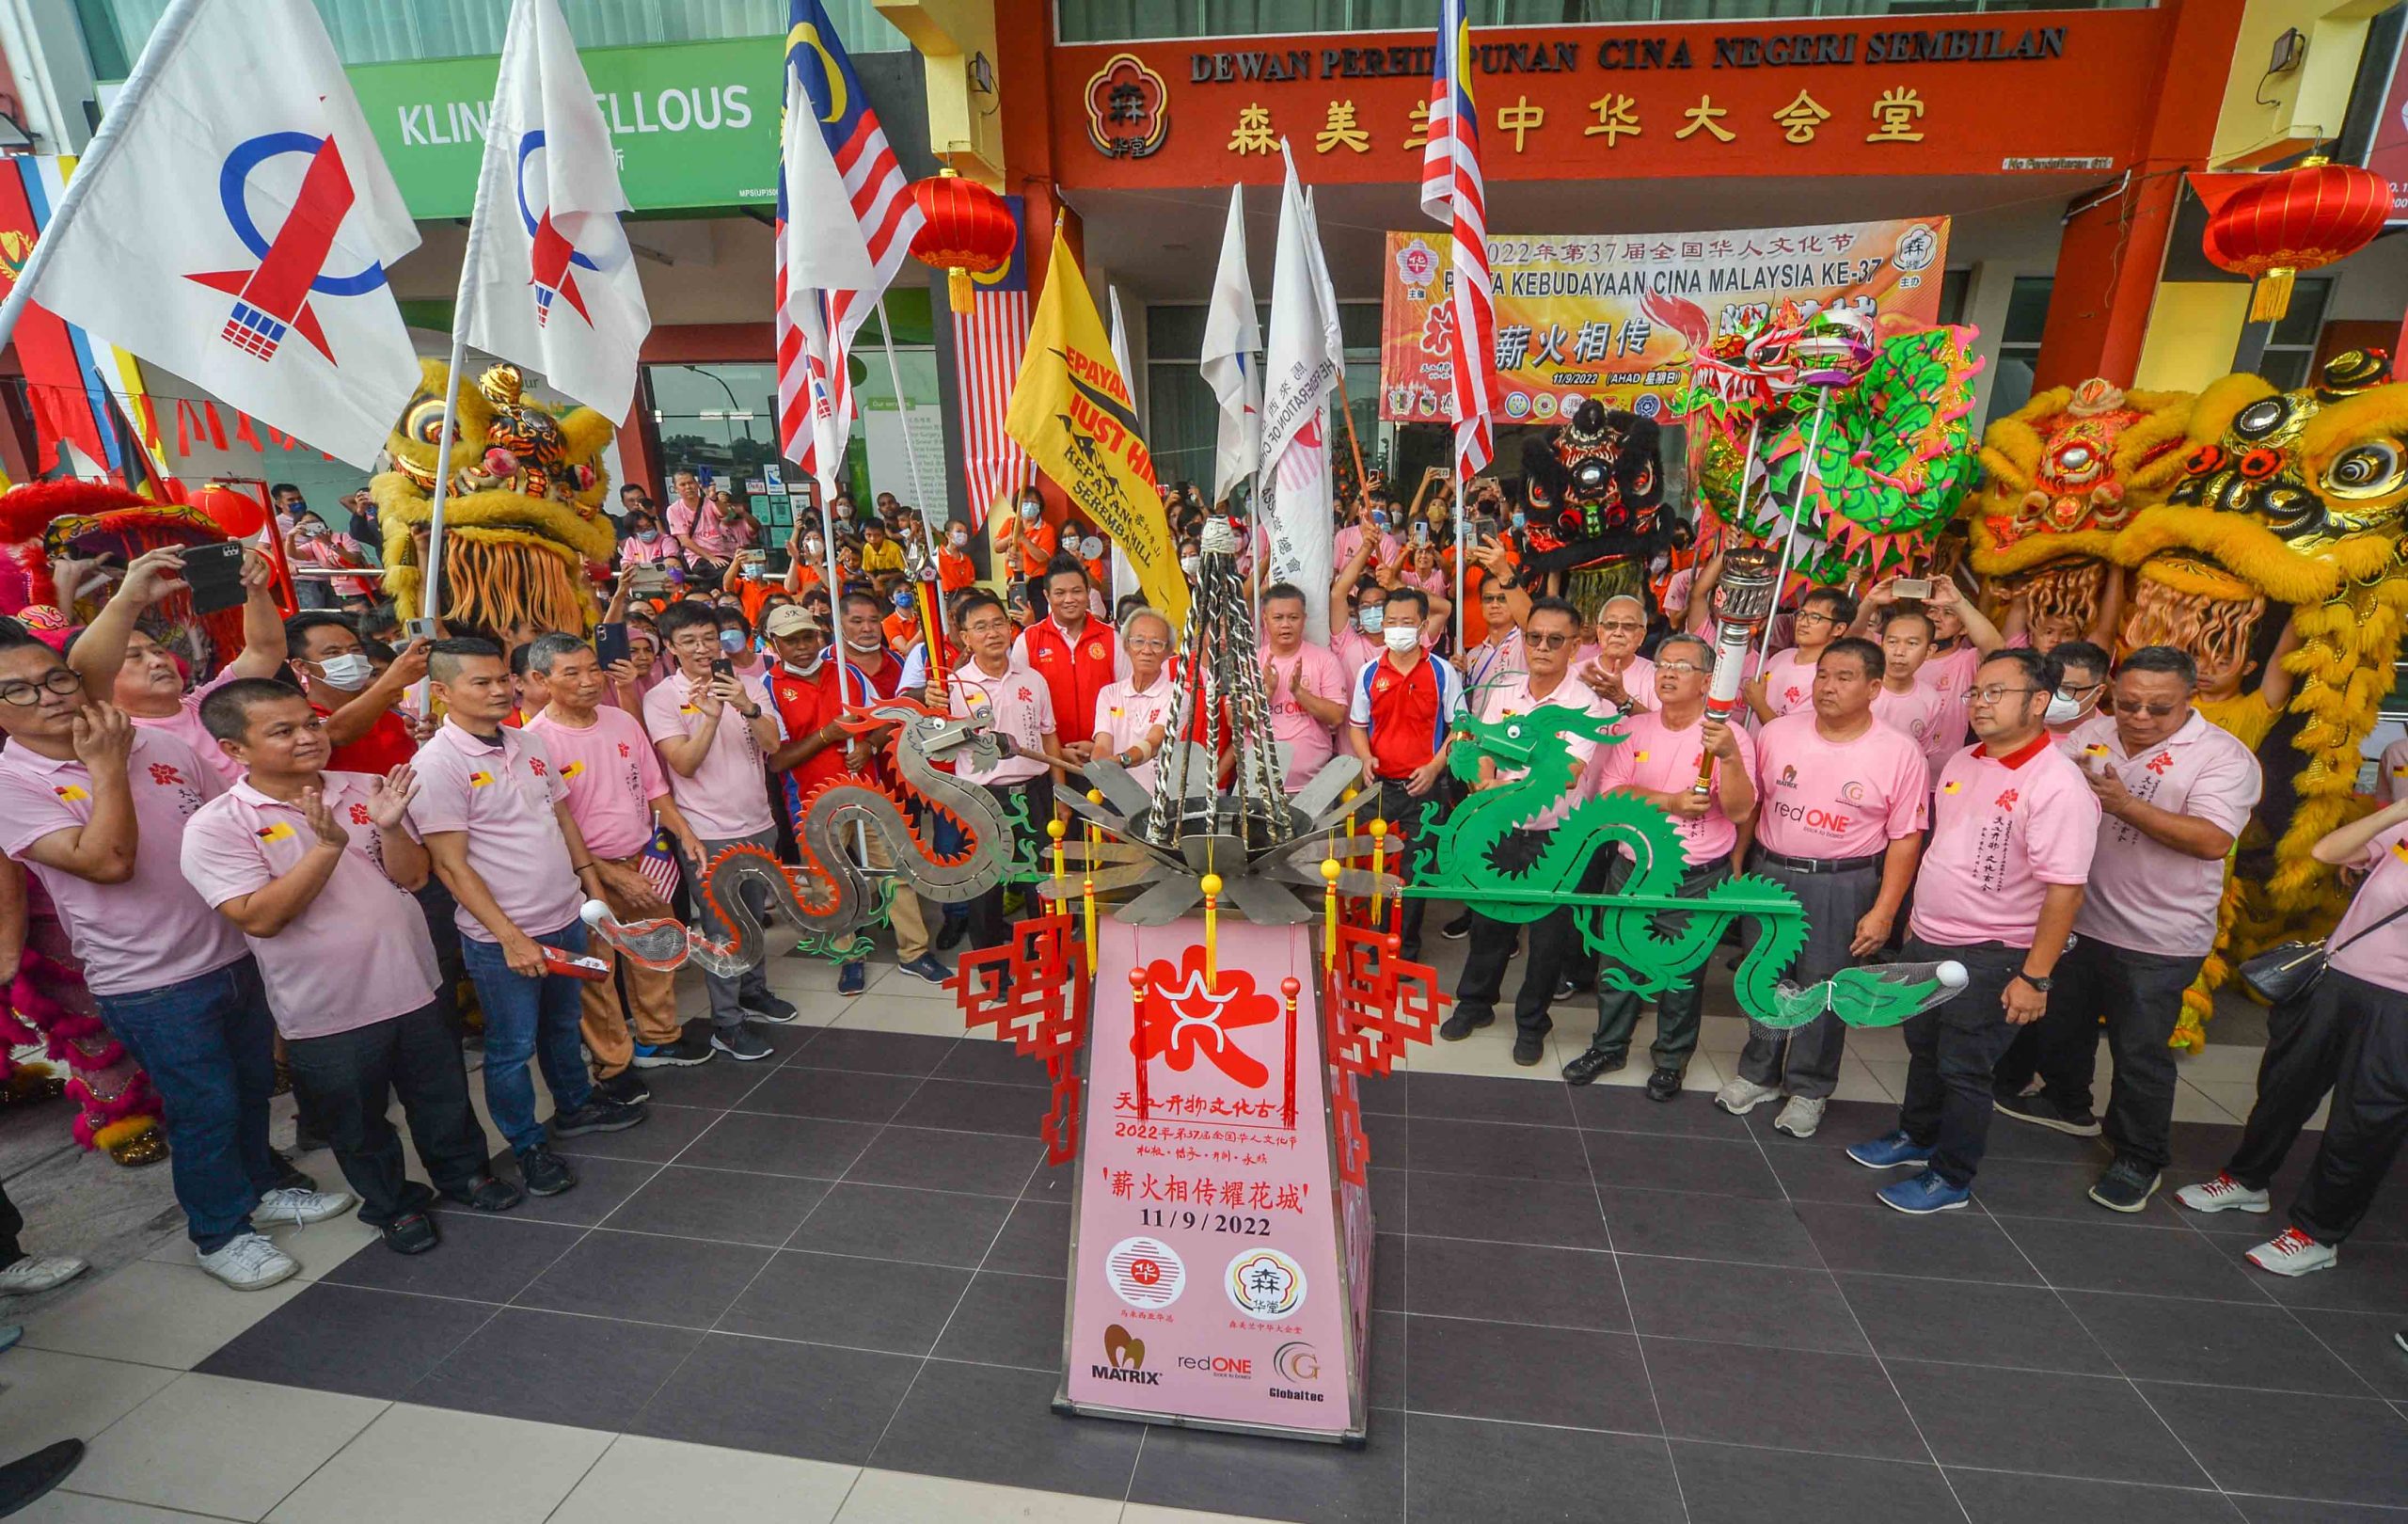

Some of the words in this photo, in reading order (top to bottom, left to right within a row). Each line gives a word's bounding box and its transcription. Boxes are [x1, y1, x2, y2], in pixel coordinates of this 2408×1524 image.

[1192, 51, 1310, 83] DEWAN
[1322, 41, 1578, 79] PERHIUNAN
[1599, 38, 1691, 70] CINA
[1713, 33, 1858, 69] NEGERI
[1866, 27, 2067, 63] SEMBILAN
[398, 101, 493, 146] KLIN
[1487, 232, 1854, 263] 022年第37届全国华人文化节
[1512, 271, 1646, 295] KEBUDAYAAN
[1655, 269, 1703, 294] CINA
[1709, 262, 1814, 292] MALAYSIA
[1822, 259, 1882, 286] KE-37
[1495, 317, 1651, 370] 薪火相传
[1553, 373, 1598, 385] 11/9/2022
[1069, 392, 1127, 454] JUST
[1776, 779, 1798, 789] MATRIX
[1133, 1262, 1158, 1281] 华
[1250, 1268, 1281, 1294] 森
[1092, 1365, 1160, 1386] MATRIX
[1269, 1387, 1324, 1403] Globaltec
